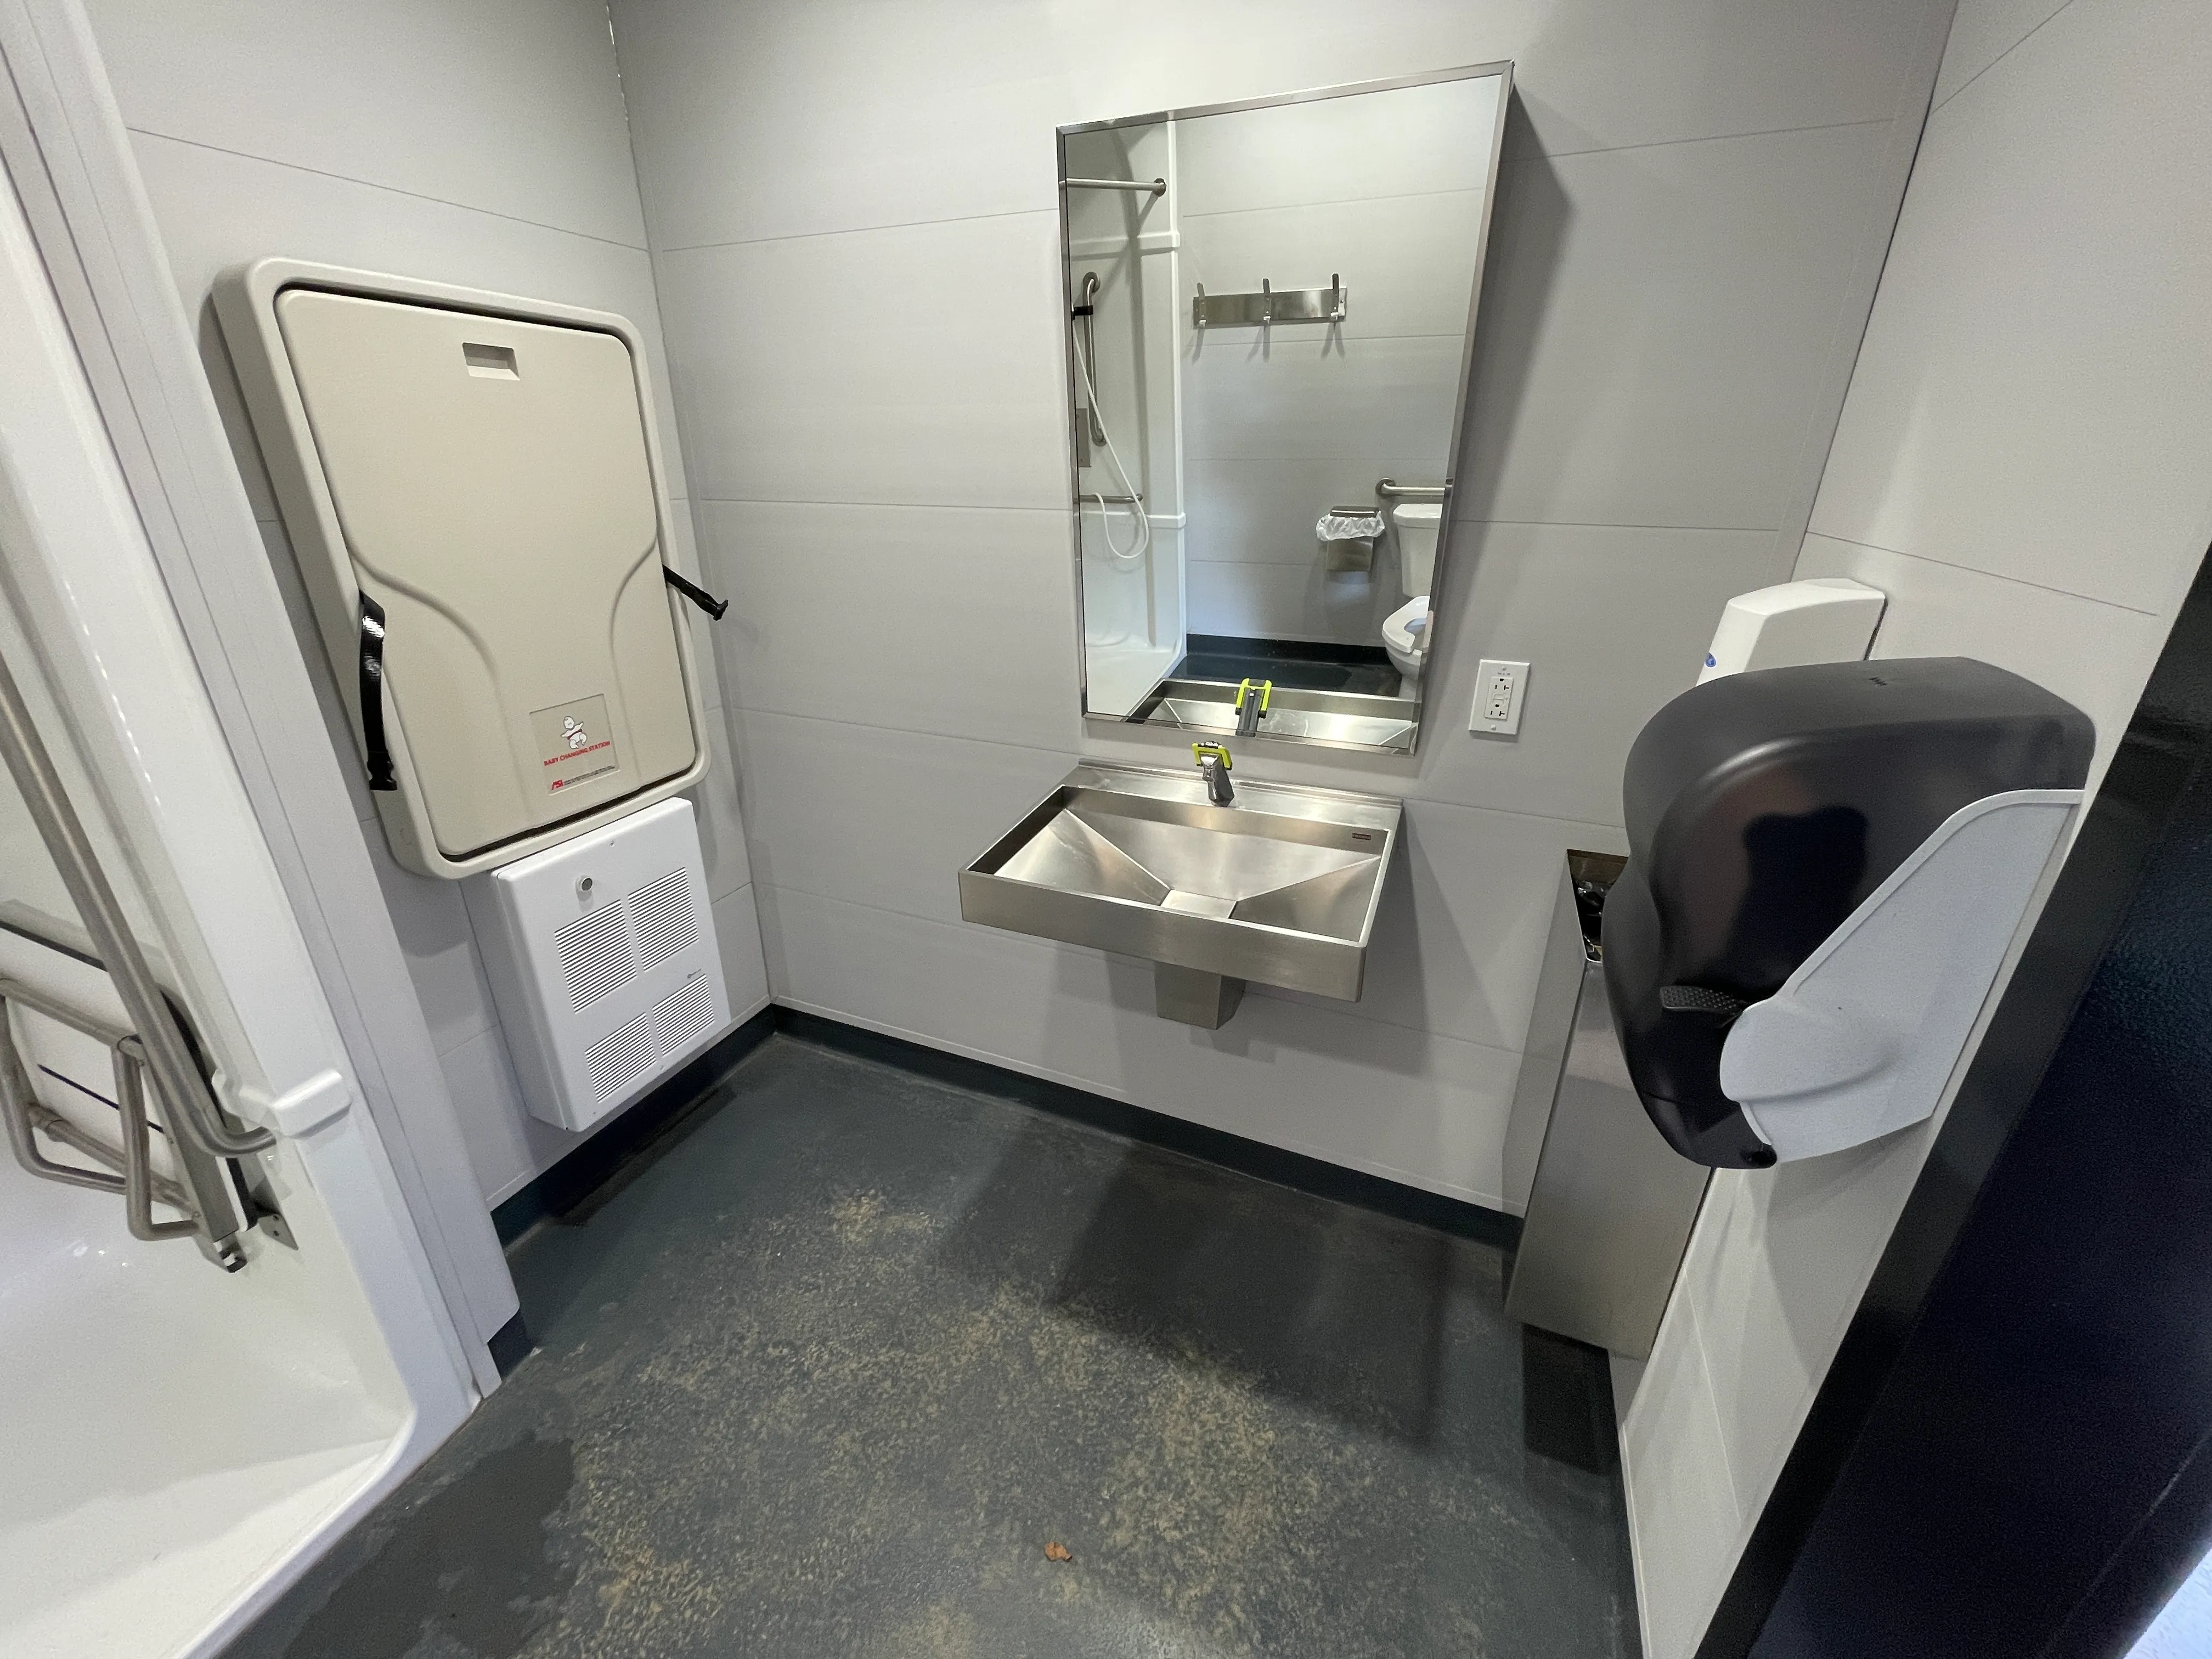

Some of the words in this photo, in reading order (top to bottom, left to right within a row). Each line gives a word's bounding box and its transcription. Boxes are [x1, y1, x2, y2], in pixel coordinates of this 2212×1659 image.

[544, 757, 558, 766] BABY
[560, 748, 588, 760] CHANGING
[589, 741, 611, 752] STATION
